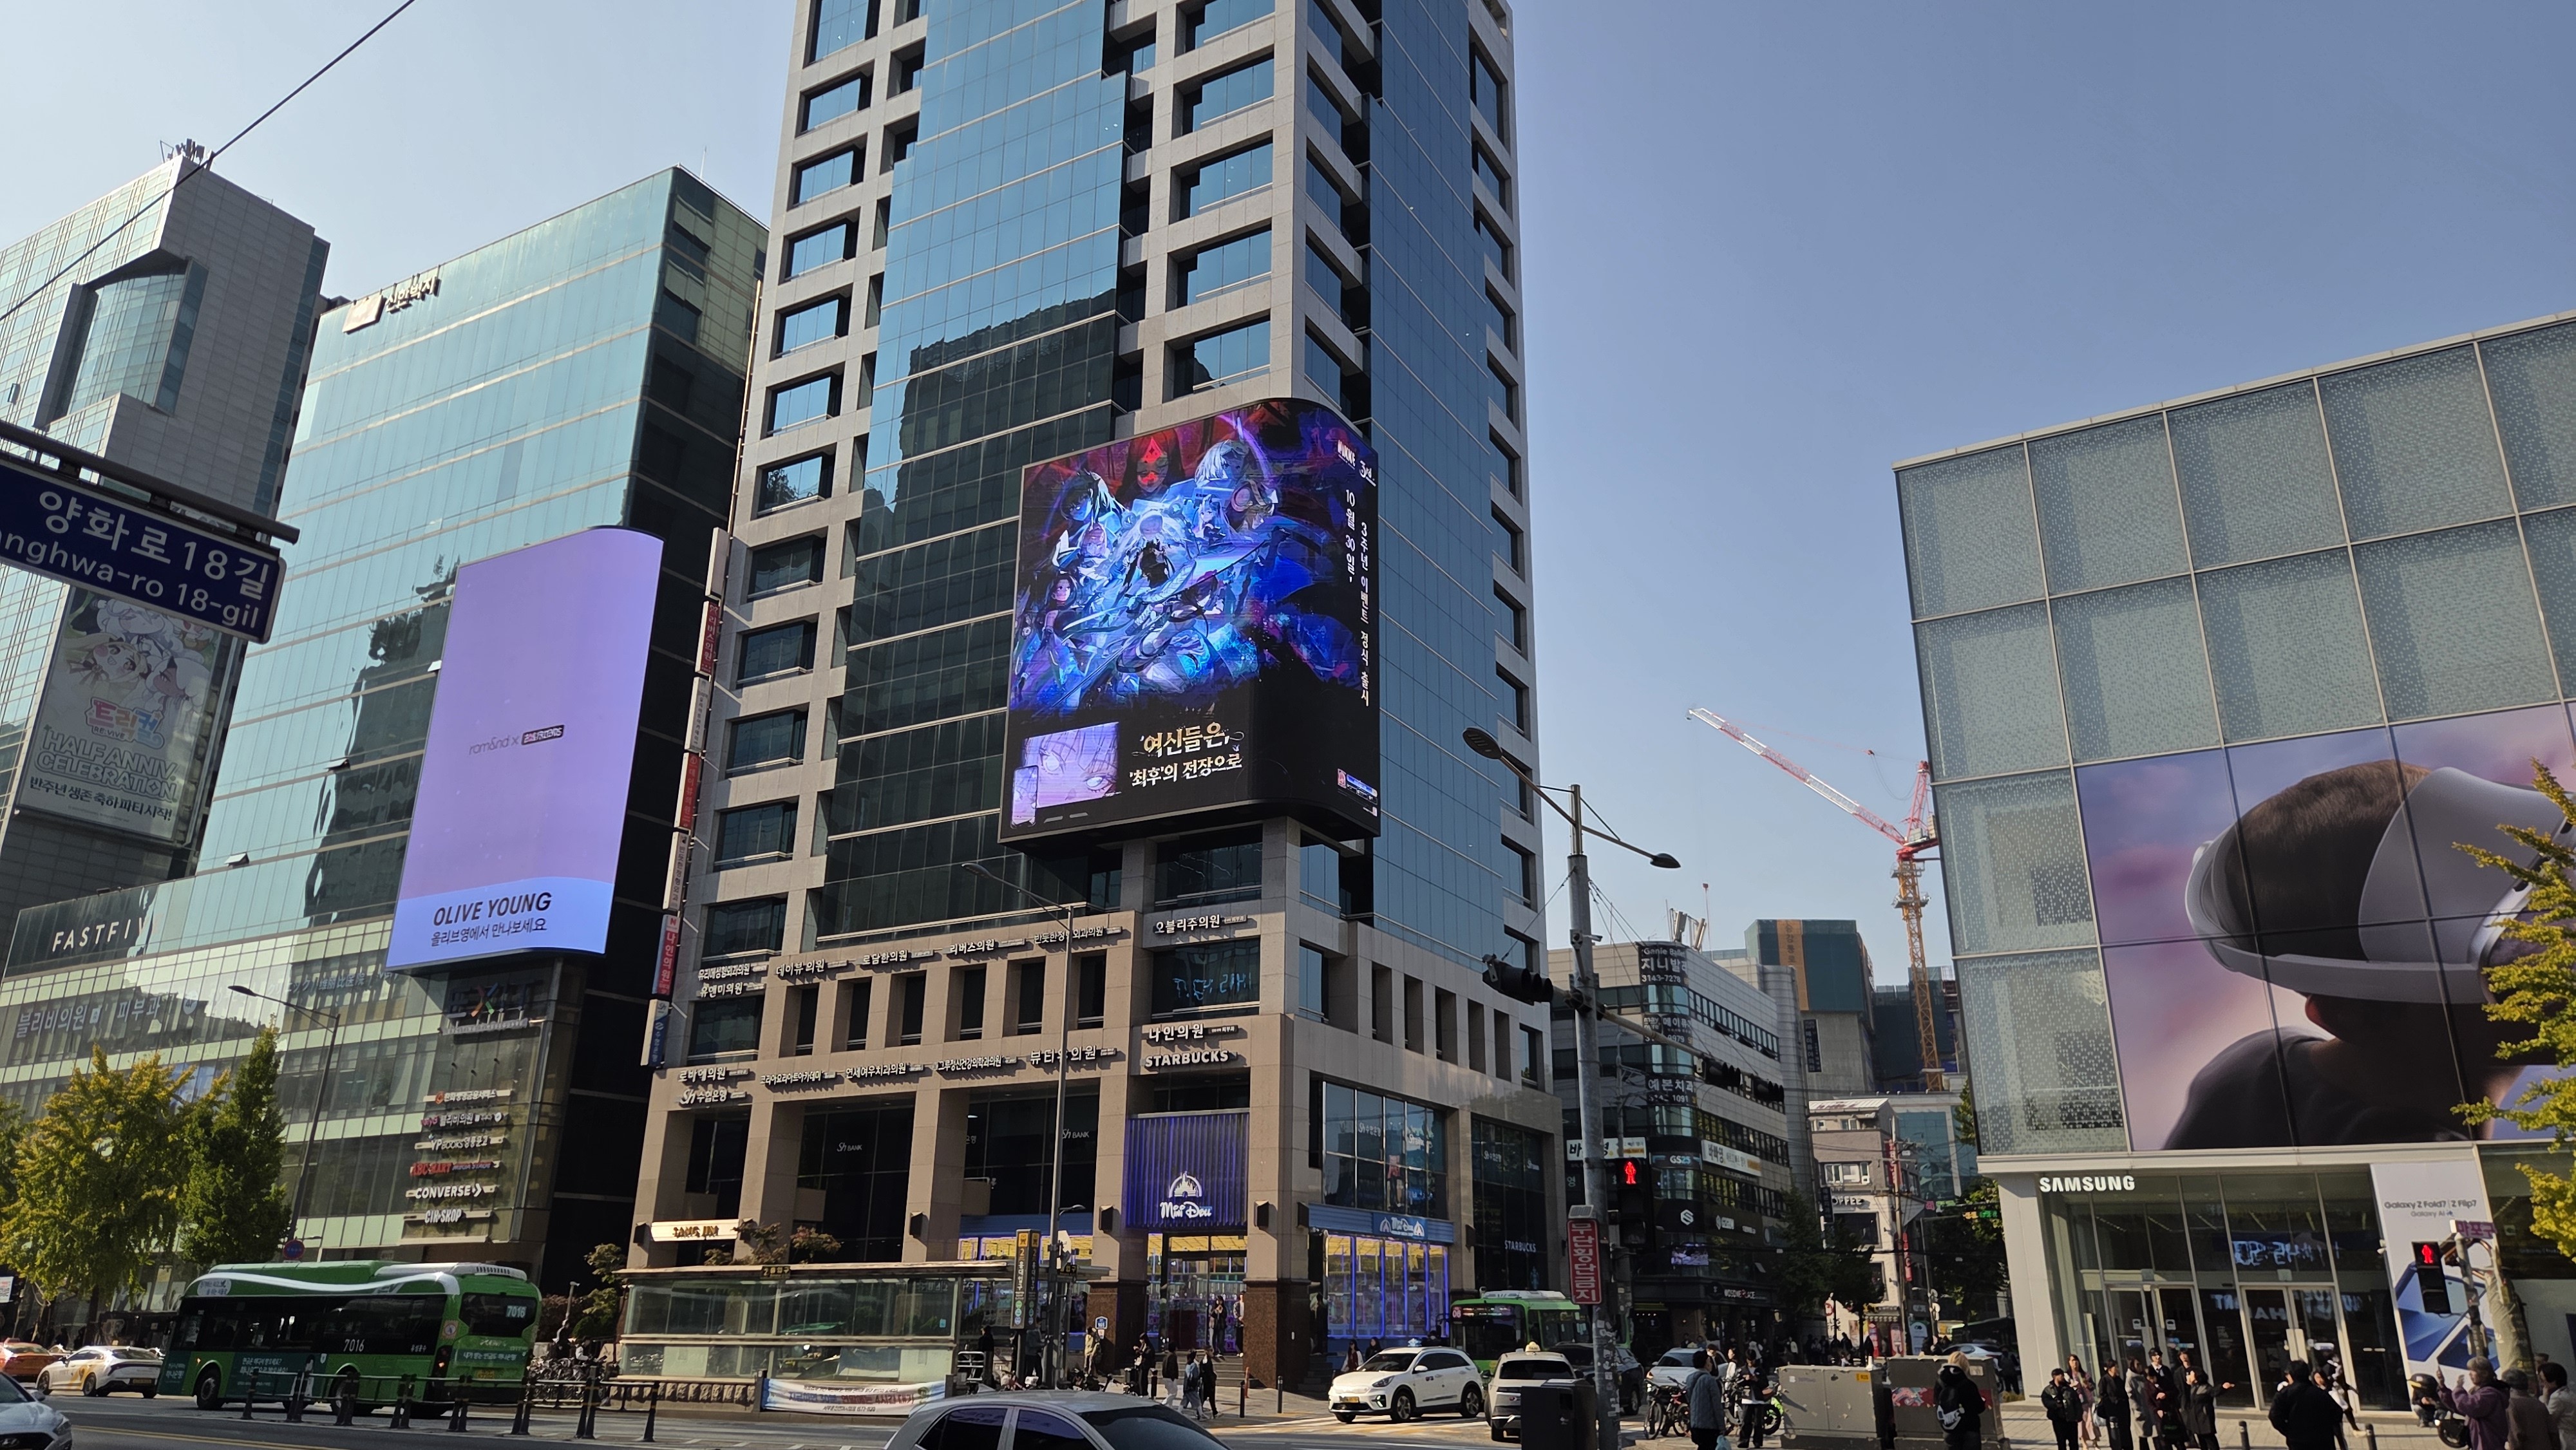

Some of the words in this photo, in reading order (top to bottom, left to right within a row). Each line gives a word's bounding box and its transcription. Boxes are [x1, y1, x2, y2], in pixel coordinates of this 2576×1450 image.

[1345, 489, 1356, 531] 10월
[39, 491, 269, 600] 양화로18길
[1360, 522, 1368, 571] 3주년
[178, 583, 259, 628] 18-gil
[1360, 576, 1369, 625] 이벤트
[705, 617, 717, 661] 리버스의원
[1361, 630, 1368, 666] 정식
[1361, 672, 1369, 707] 출시
[43, 730, 107, 761] HALF
[103, 748, 178, 781] ANNIV.
[37, 751, 178, 800] CELEBRATION
[1182, 753, 1244, 780] 전장으로
[30, 776, 67, 796] 반주년
[68, 786, 92, 802] 생존
[93, 793, 119, 809] 축하
[119, 800, 144, 815] 파티
[144, 805, 173, 822] 시작!
[433, 901, 482, 927] OLIVE
[488, 892, 552, 919] YOUNG
[431, 927, 489, 947] 올리브영에서
[491, 918, 547, 938] 만나보세요
[1154, 914, 1221, 934] 오블리주의원
[1034, 926, 1104, 945] 반듯한정외과의원
[661, 932, 676, 983] 나인의원
[950, 939, 995, 956] 리버스의원
[776, 962, 804, 977] 데이뷰
[806, 959, 825, 974] 의원
[863, 950, 908, 966] 로담한의원
[16, 1004, 89, 1039] 블리비의원
[117, 995, 161, 1022] 피부과
[1149, 1022, 1204, 1042] 나인의원
[1144, 1050, 1229, 1068] STARBUCKS
[846, 1062, 907, 1079] 연세여우치과의원
[1072, 1131, 1090, 1139] BANK
[1669, 1155, 1690, 1164] GS25
[415, 1185, 471, 1199] CONVERSE
[2040, 1175, 2136, 1192] SAMSUNG
[1160, 1201, 1183, 1219] Mini
[1832, 1195, 1863, 1206] OFFEE
[2384, 1201, 2416, 1210] Galaxy
[2456, 1222, 2496, 1239] 마포구
[1019, 1248, 1025, 1256] 2
[1504, 1239, 1537, 1253] STARBUCKS
[1571, 1223, 1596, 1302] 무단횡단금지
[507, 1305, 527, 1319] 7016
[343, 1339, 365, 1353] 7016
